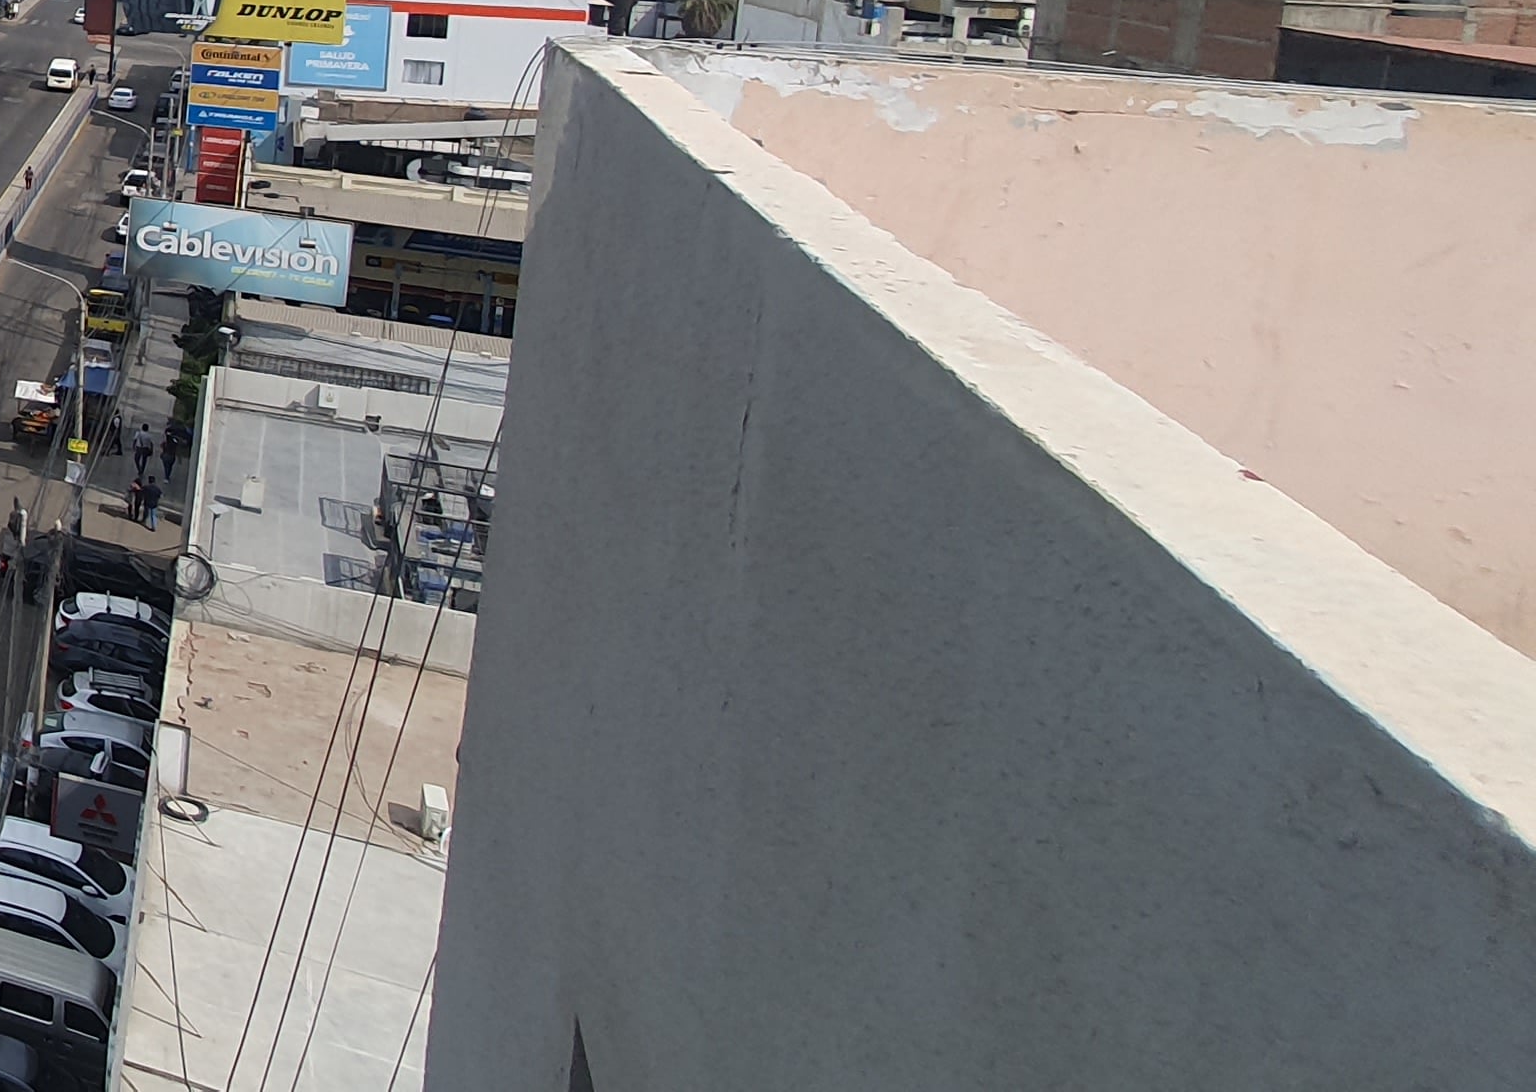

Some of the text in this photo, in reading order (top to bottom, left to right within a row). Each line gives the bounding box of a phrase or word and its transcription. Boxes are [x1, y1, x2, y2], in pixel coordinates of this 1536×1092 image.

[236, 3, 343, 22] DUNLOP
[200, 48, 261, 62] Continental
[319, 50, 356, 60] SALUD
[305, 59, 370, 71] PRIMAVERA
[206, 69, 265, 81] FALKEN
